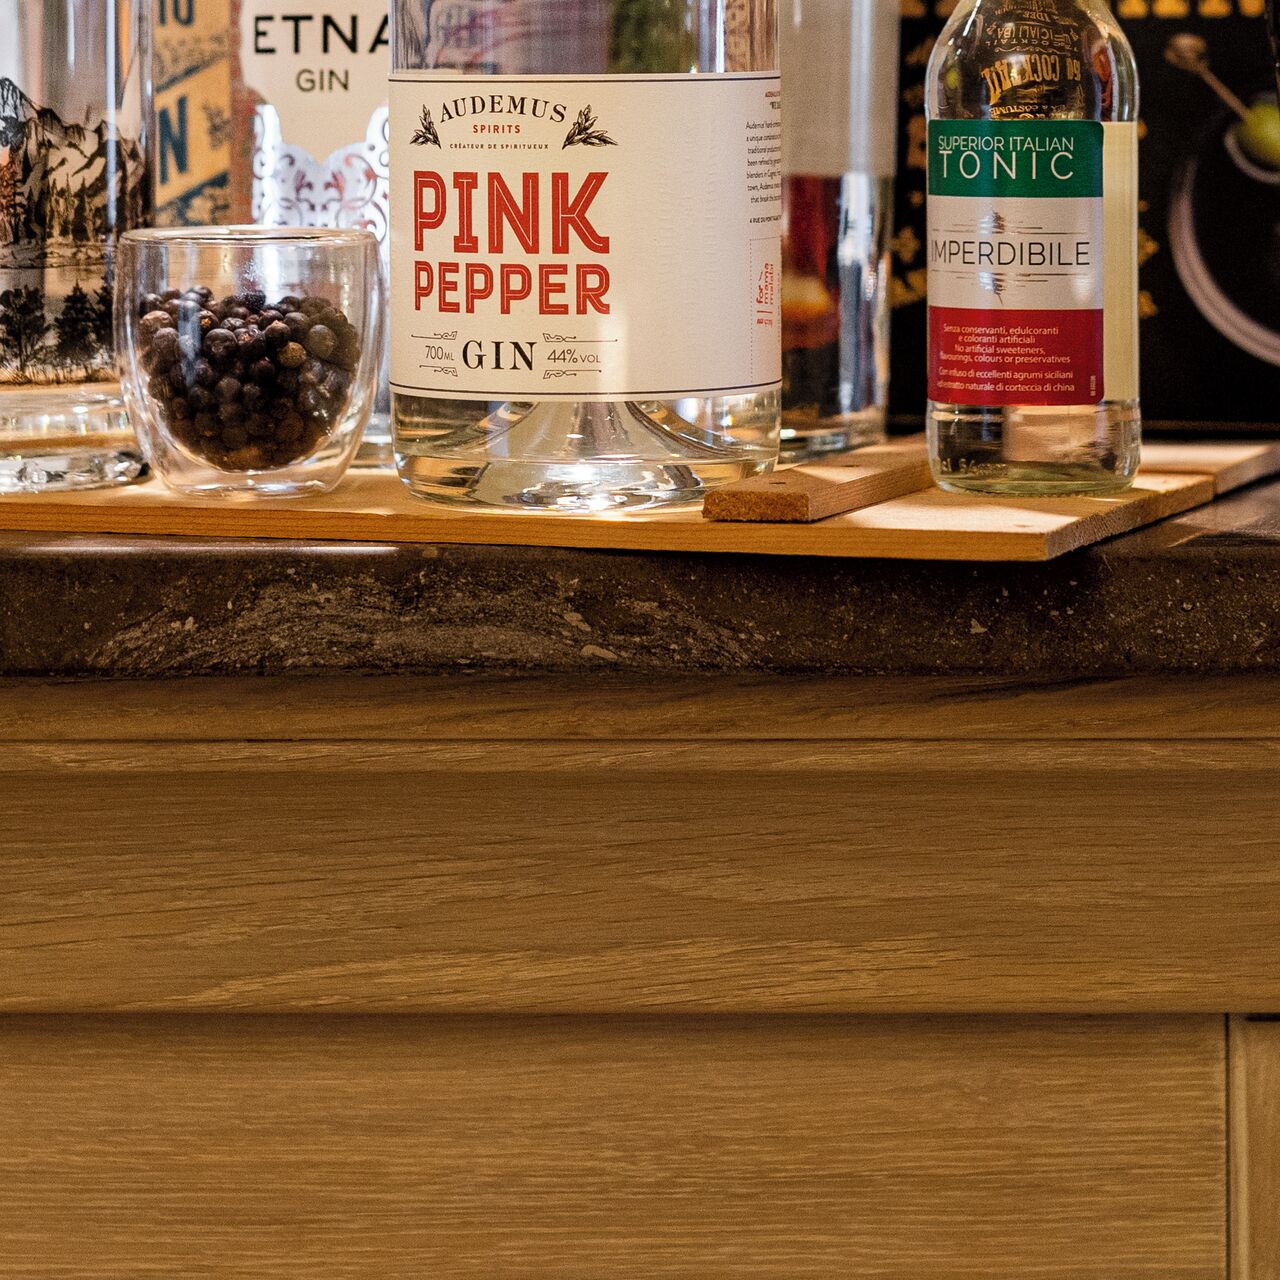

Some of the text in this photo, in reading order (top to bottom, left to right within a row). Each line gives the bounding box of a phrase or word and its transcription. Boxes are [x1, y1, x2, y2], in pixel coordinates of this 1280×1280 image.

[296, 69, 349, 92] GIN
[440, 95, 567, 123] AUDEMUS
[472, 124, 521, 134] SPIRITS
[500, 143, 549, 151] SPIRITUEUX
[938, 135, 1074, 151] SUPERIOR ITALIAN
[939, 150, 1074, 180] TONIC
[413, 170, 610, 255] PINK
[931, 240, 1090, 266] IMPERDIBILE
[414, 260, 611, 316] PEPPER
[961, 325, 1008, 335] conservanti,
[1009, 326, 1059, 335] edulcoranti
[964, 334, 998, 344] coloranti
[999, 335, 1036, 344] artificiali
[462, 339, 538, 371] GIN
[547, 349, 578, 363] 44%
[579, 355, 602, 363] VOL
[965, 344, 995, 354] artificial
[996, 347, 1046, 356] sweeteners,
[974, 354, 1003, 363] colours
[1015, 355, 1071, 365] preservatives
[976, 370, 1012, 379] eccellenti
[1013, 371, 1043, 381] agrumi
[1044, 371, 1074, 379] siciliani
[995, 383, 1003, 391] di
[1005, 384, 1042, 392] corteccia
[1043, 384, 1052, 392] di
[1053, 383, 1075, 392] china
